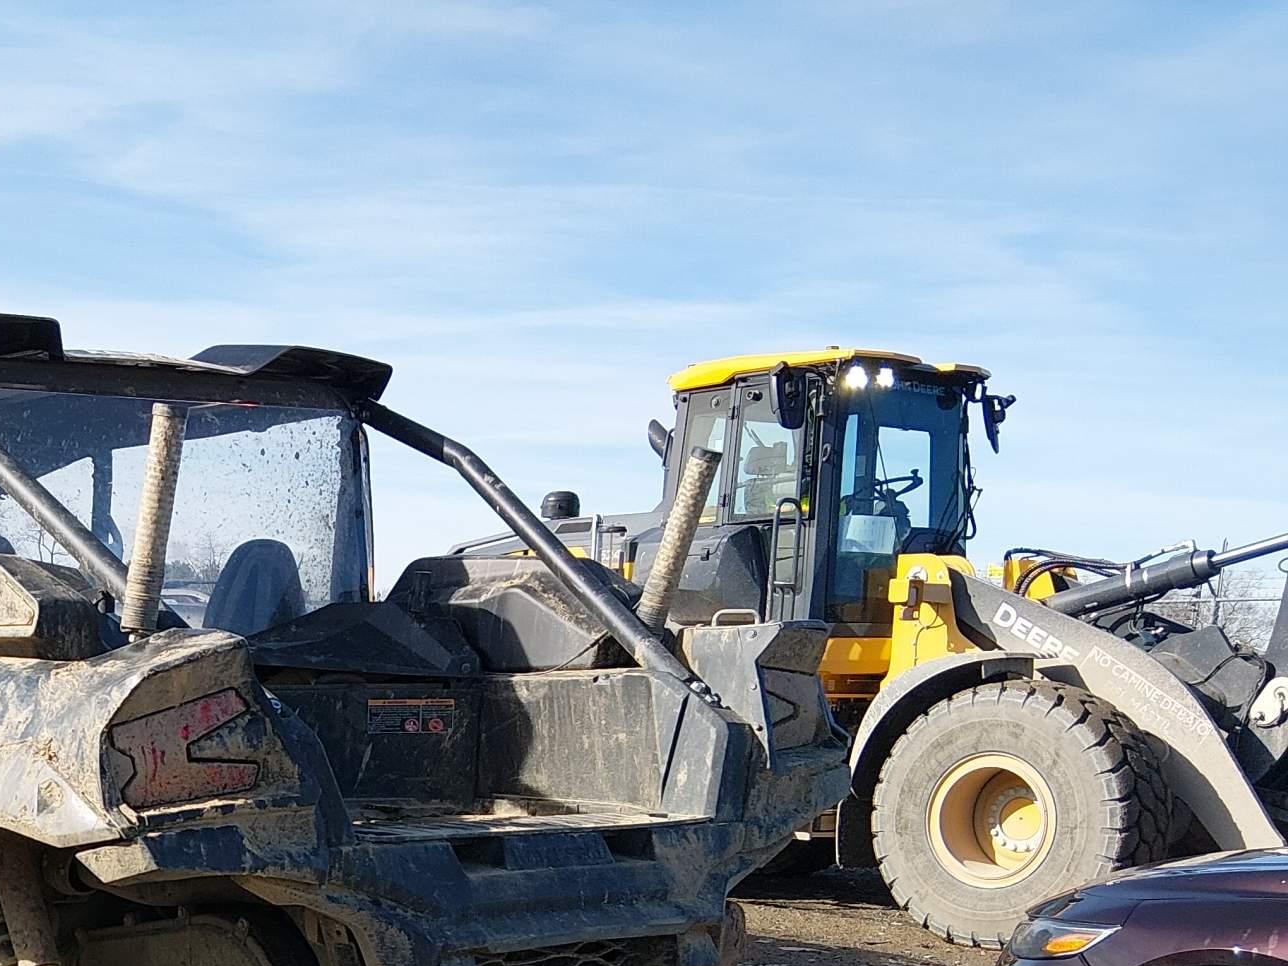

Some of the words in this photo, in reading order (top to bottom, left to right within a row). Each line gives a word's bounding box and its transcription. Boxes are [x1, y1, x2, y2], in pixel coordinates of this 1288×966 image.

[913, 382, 946, 396] DEERE
[993, 602, 1080, 664] DEERE
[1092, 649, 1111, 668] NO
[1112, 662, 1161, 702] CAMINE
[1161, 695, 1210, 737] DEBAJO
